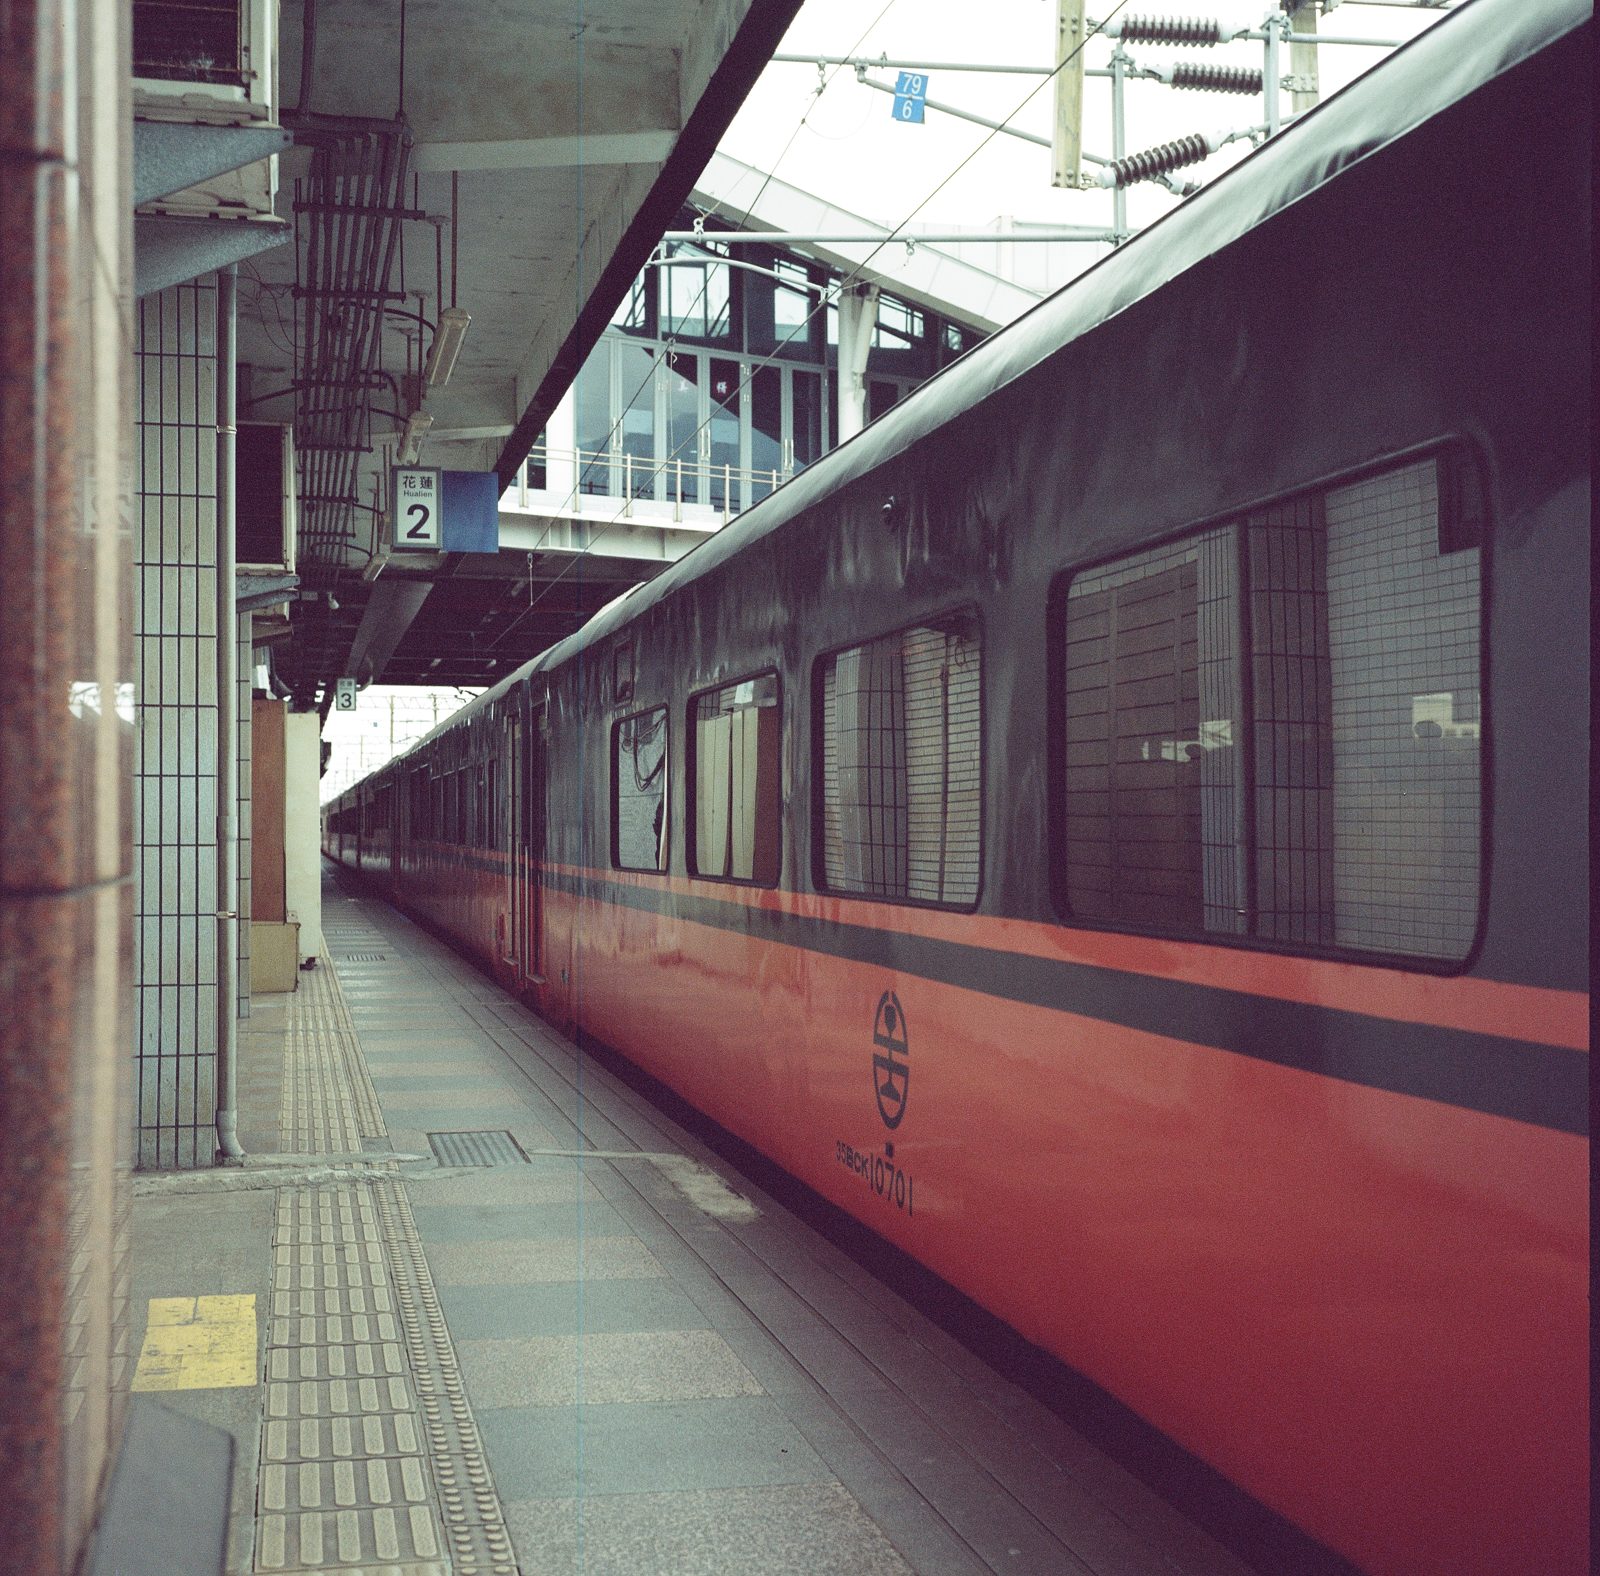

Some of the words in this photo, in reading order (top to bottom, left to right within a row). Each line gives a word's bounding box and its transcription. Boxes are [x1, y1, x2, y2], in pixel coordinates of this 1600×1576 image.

[903, 74, 922, 95] 79
[902, 100, 913, 119] 6
[403, 475, 432, 489] 花蓮
[403, 490, 433, 498] Hualien
[407, 503, 431, 539] 2
[341, 692, 352, 708] 3
